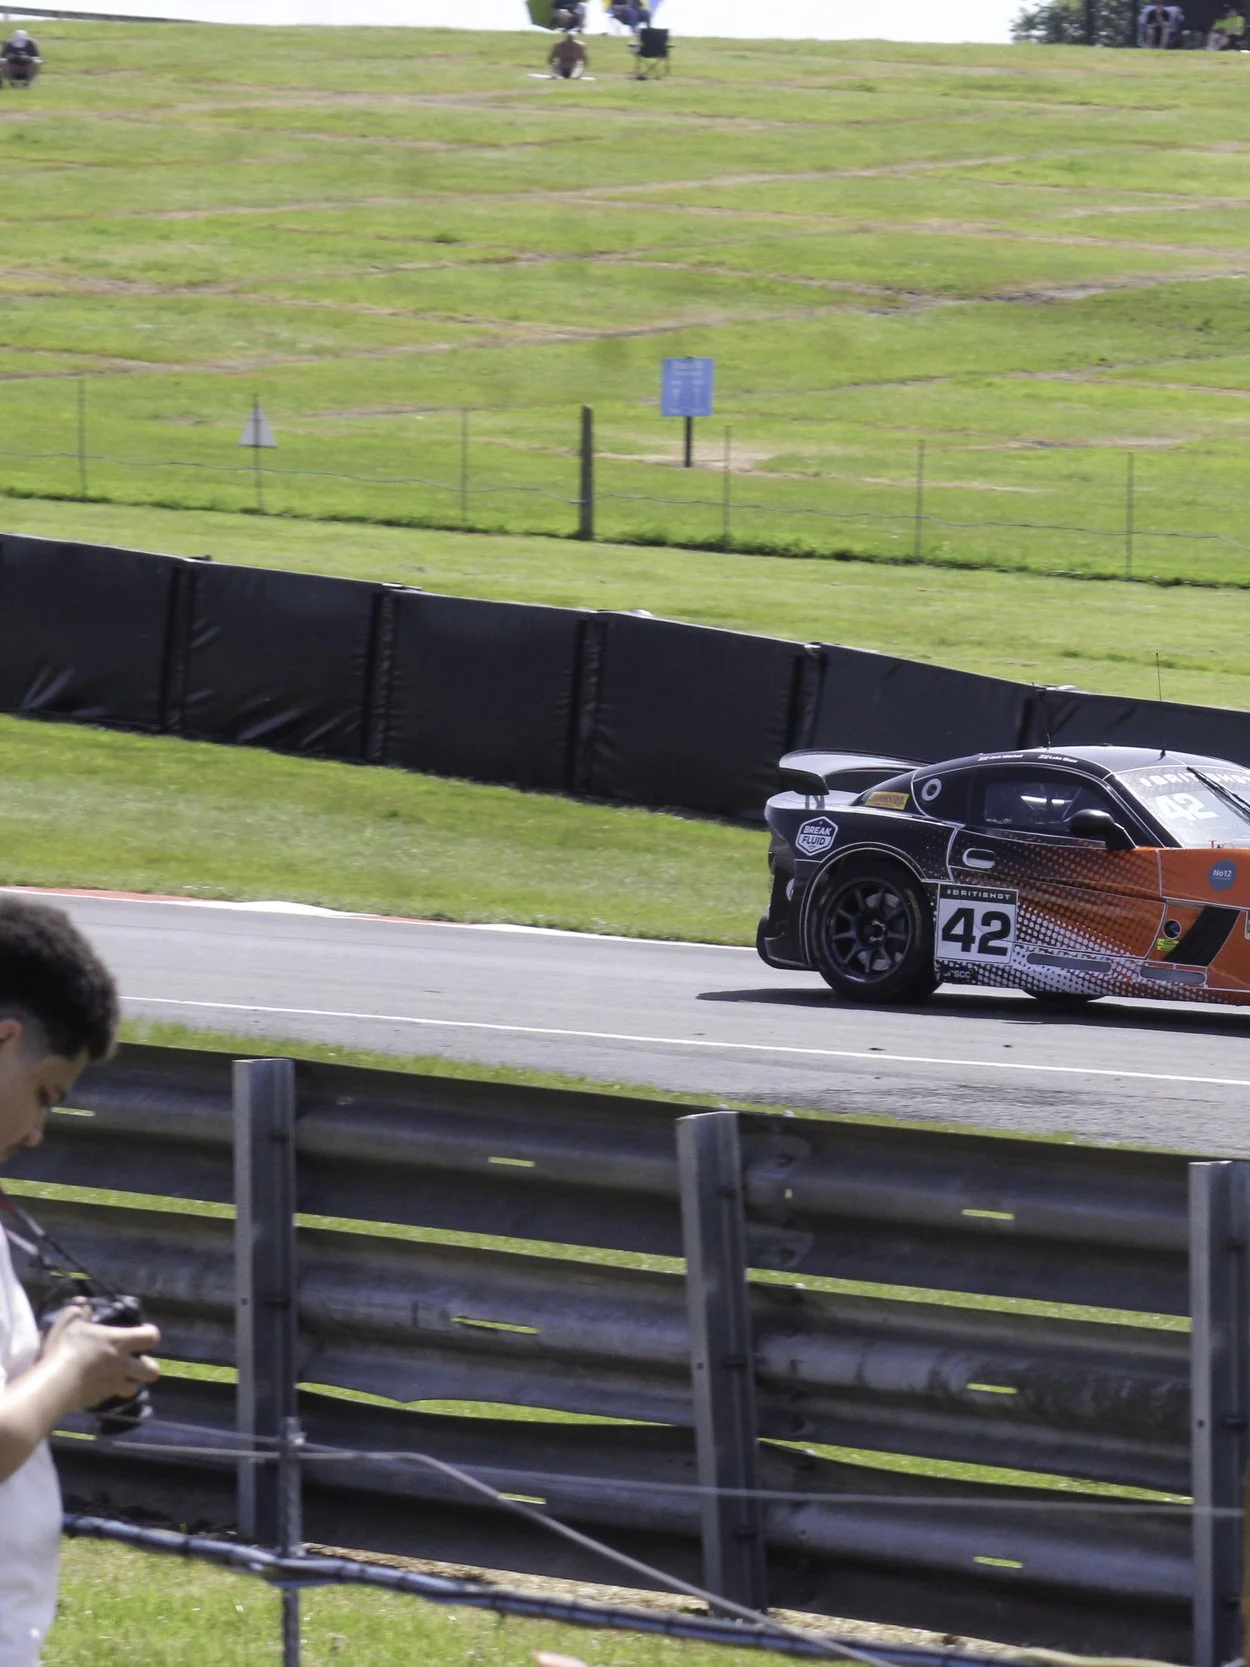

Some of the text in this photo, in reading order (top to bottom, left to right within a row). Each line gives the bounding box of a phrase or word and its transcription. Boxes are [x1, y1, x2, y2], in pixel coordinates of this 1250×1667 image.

[1154, 793, 1219, 821] 42
[803, 825, 832, 836] BREAK
[802, 836, 826, 846] FLUID
[1212, 869, 1232, 877] No12
[946, 889, 1011, 900] #BRITISHGT
[941, 907, 1012, 957] 42
